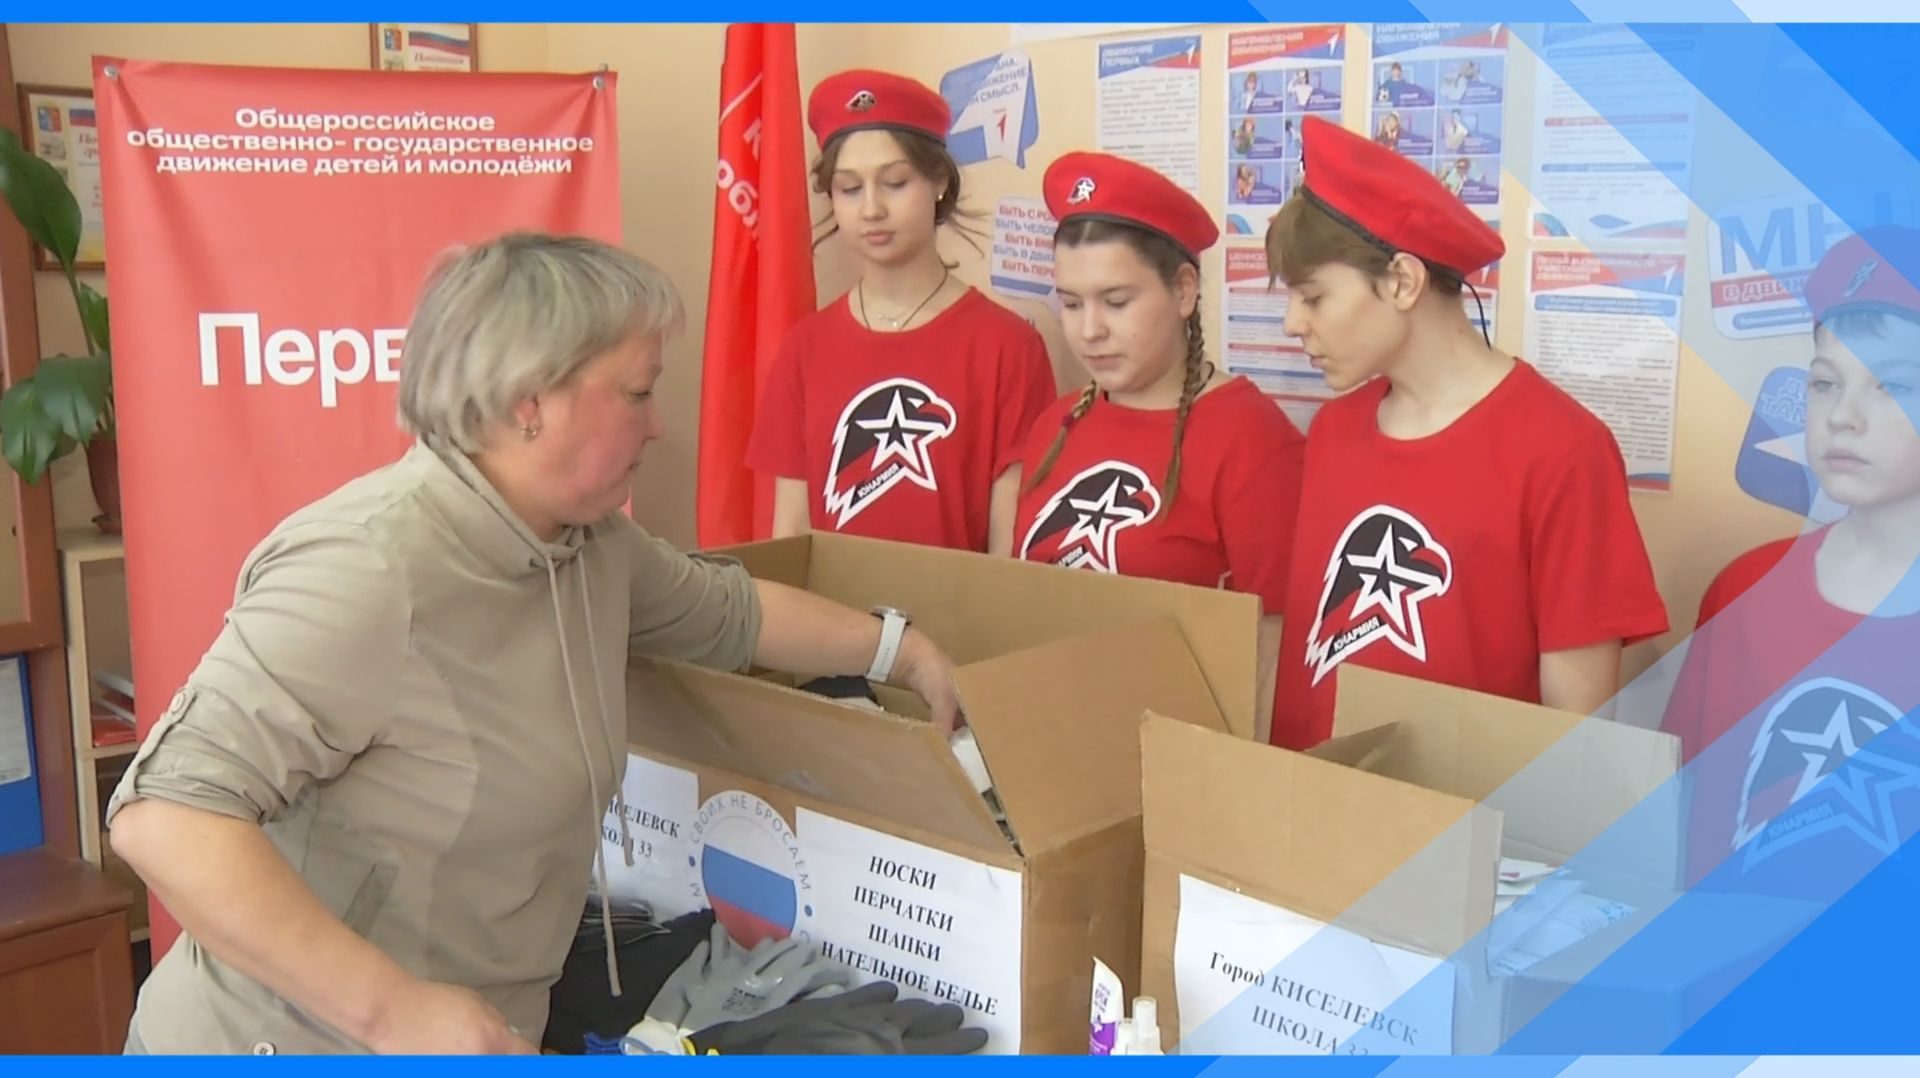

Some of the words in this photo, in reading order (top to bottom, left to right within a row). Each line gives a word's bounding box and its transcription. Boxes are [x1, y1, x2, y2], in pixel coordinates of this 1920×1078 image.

[235, 107, 496, 133] Общероссийское
[127, 128, 346, 153] общественно-
[353, 136, 594, 155] государственное
[156, 154, 308, 174] движение
[313, 155, 399, 175] детей
[404, 158, 422, 173] и
[429, 155, 572, 175] молодёжи
[1722, 284, 1740, 304] В
[1333, 615, 1380, 652] ЮНАРМИЯ
[730, 795, 748, 810] НЕ
[868, 855, 937, 891] НОСКИ
[853, 885, 955, 932] ПЕРЧАТКИ
[868, 923, 942, 962] ШАПКИ
[821, 941, 930, 993] НАТЕЛЬНОЕ
[933, 979, 999, 1015] БЕЛЬЕ
[1209, 951, 1265, 987] Город
[1271, 975, 1419, 1046] КИСЕЛЕВСК
[1251, 1005, 1338, 1055] ШКОЛА
